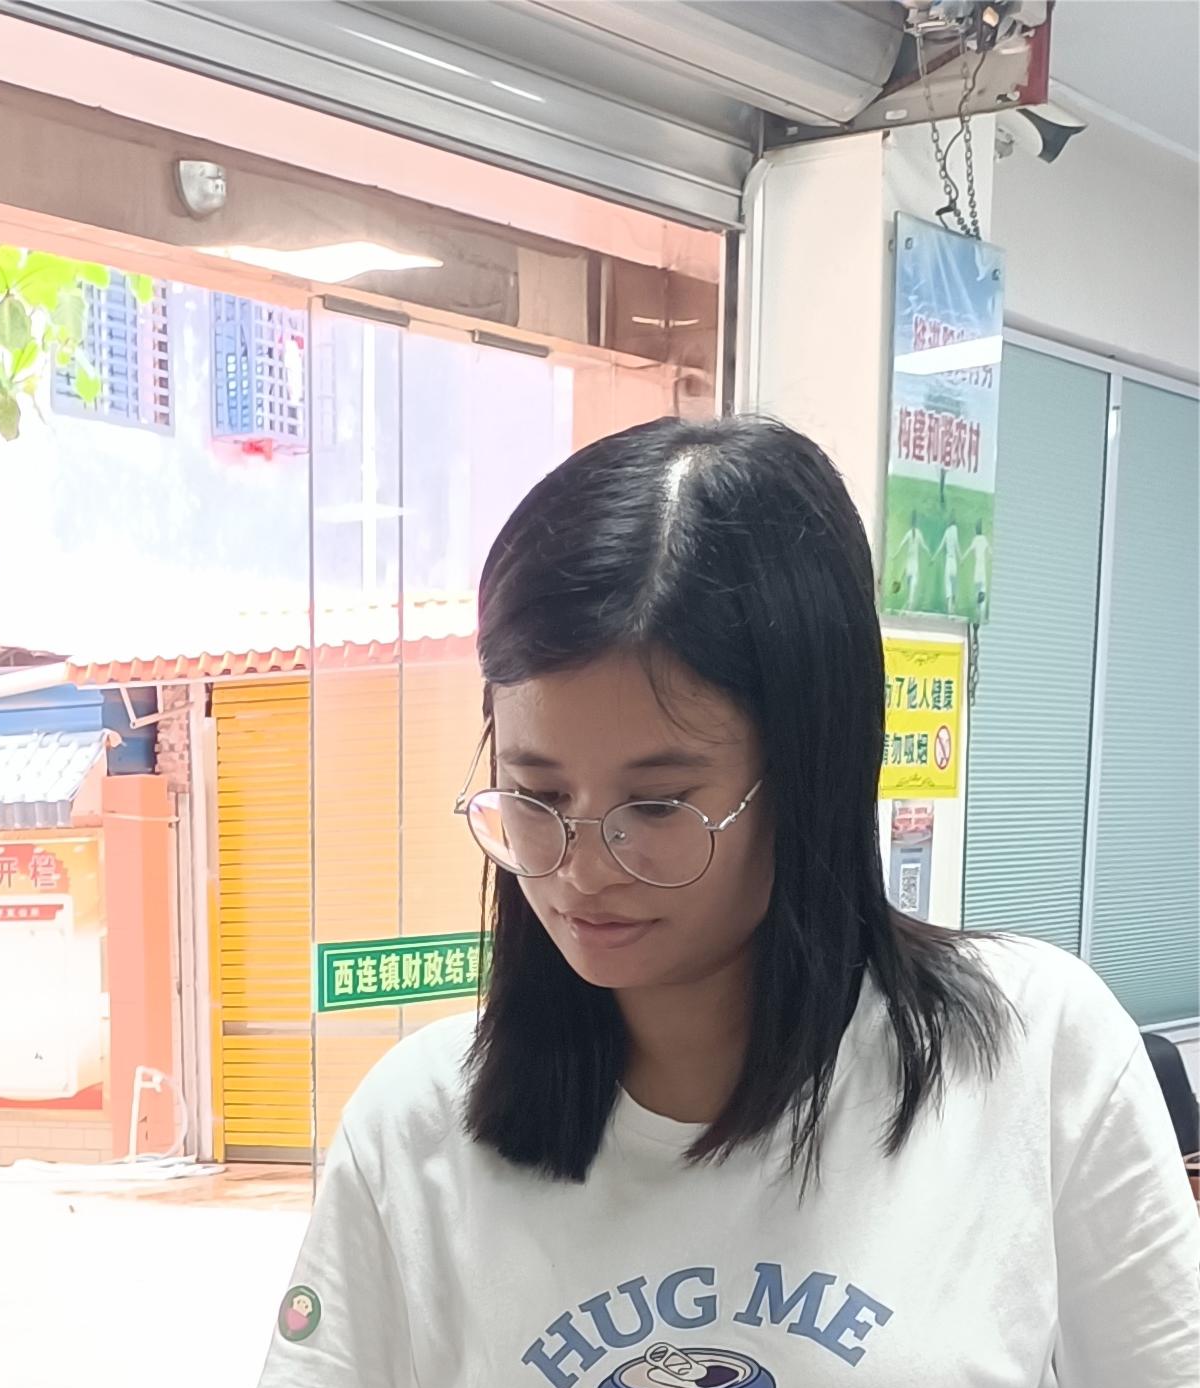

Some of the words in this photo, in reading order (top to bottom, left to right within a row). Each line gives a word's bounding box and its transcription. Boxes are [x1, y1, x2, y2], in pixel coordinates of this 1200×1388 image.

[898, 406, 980, 473] 构建和谐农村
[733, 1261, 895, 1368] ME
